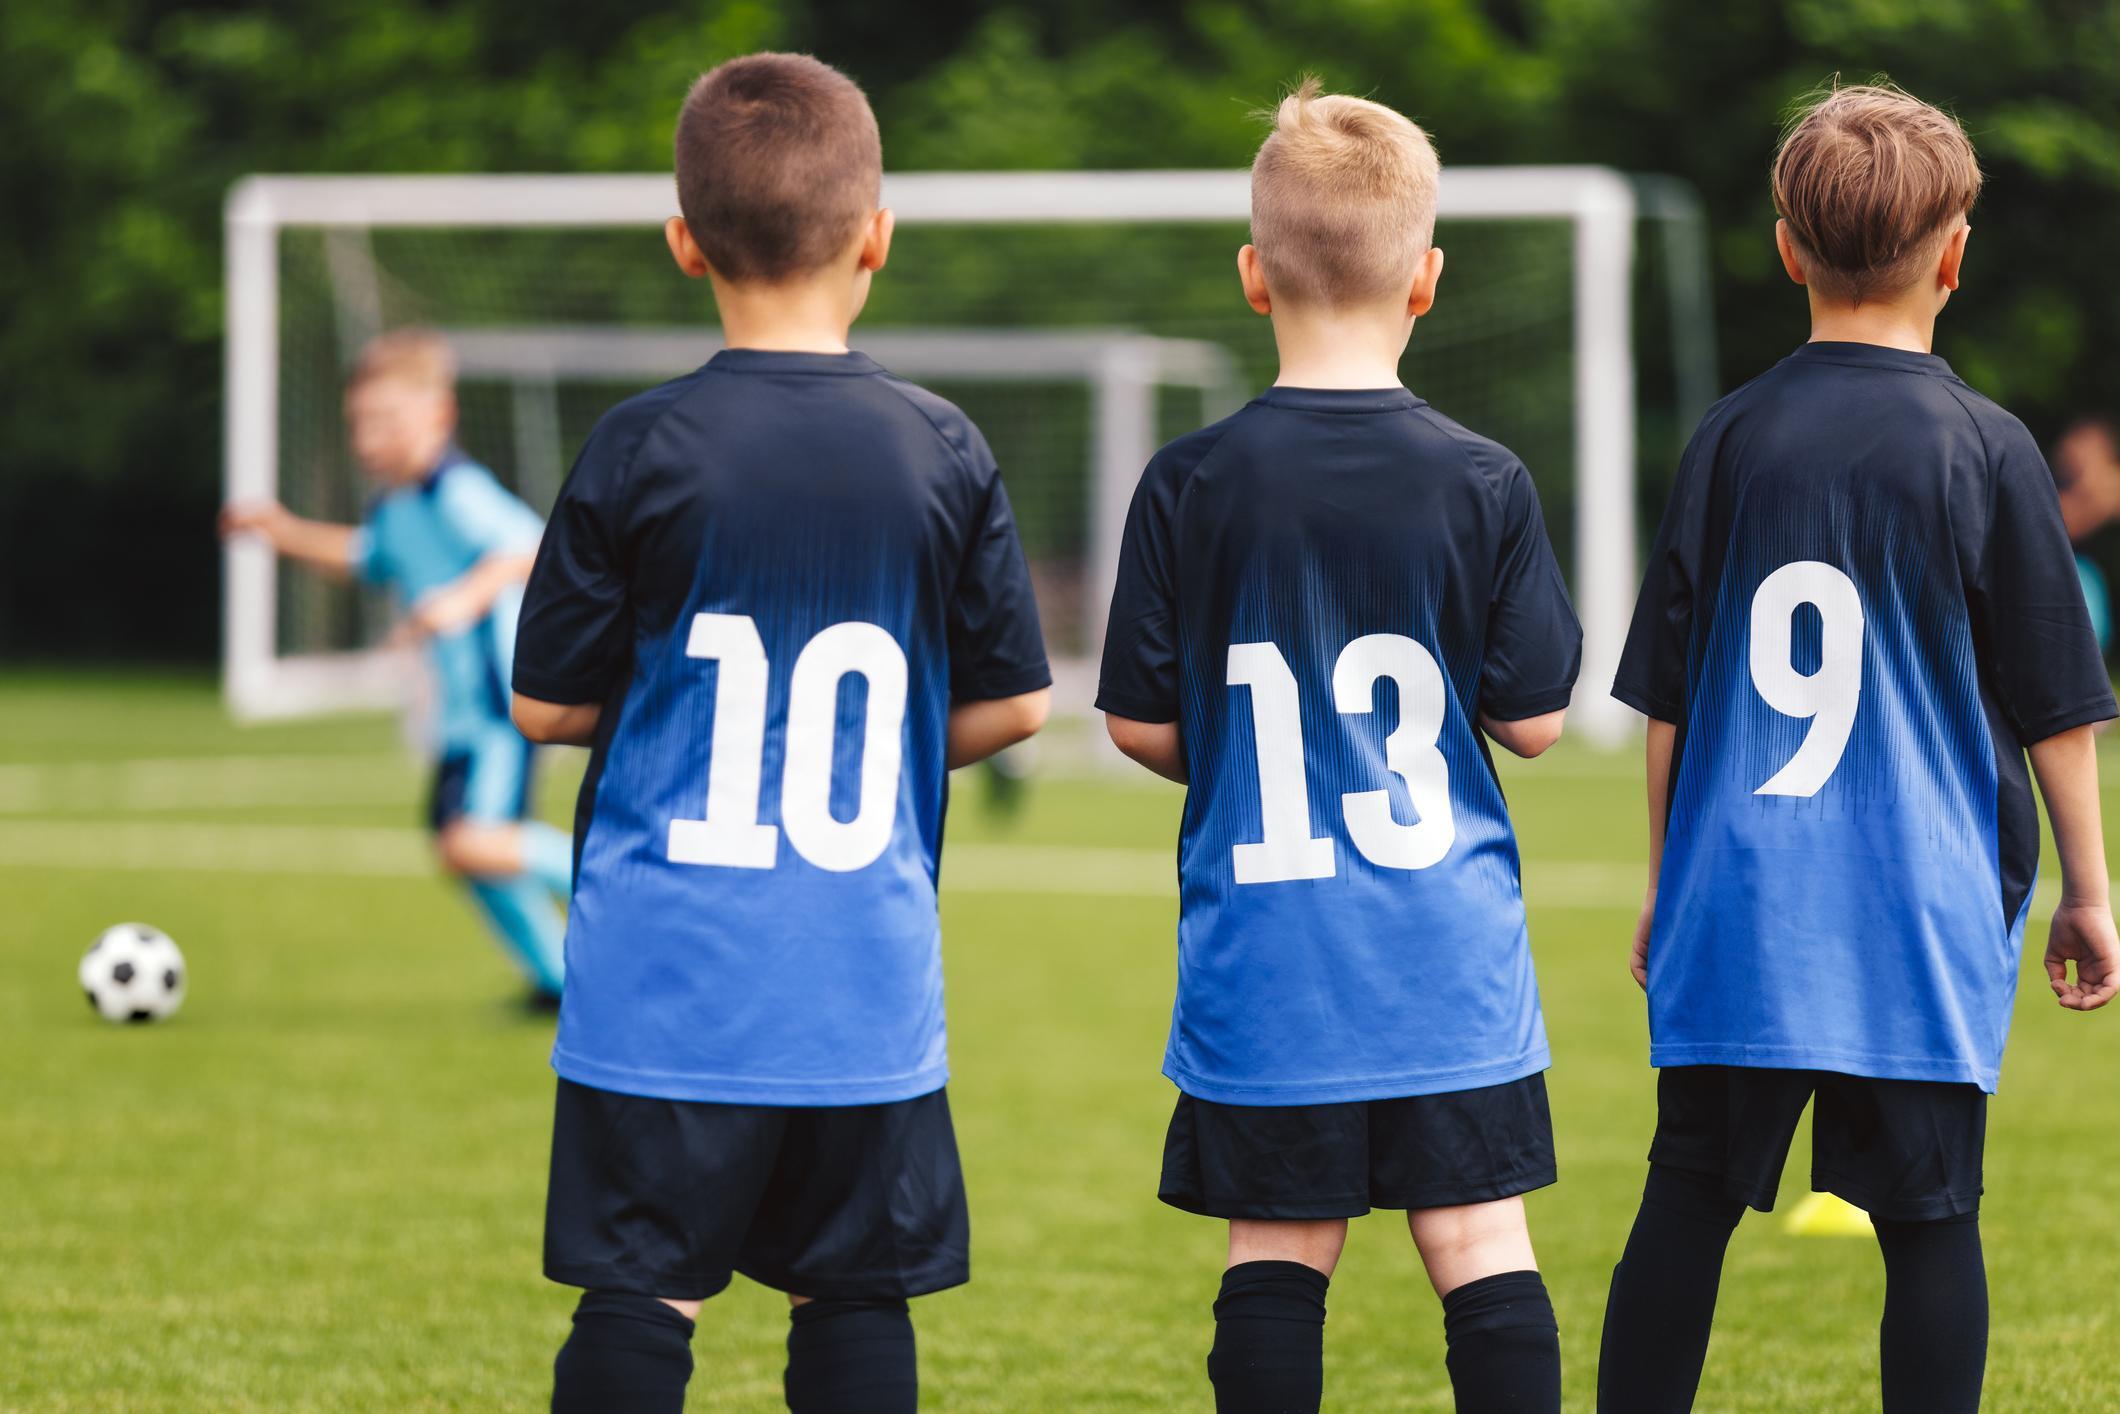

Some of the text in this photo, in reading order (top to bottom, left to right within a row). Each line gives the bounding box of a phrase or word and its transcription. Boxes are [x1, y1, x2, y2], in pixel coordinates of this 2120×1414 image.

[667, 612, 908, 873] 10
[1226, 633, 1457, 884] 13
[1749, 560, 1865, 798] 9
